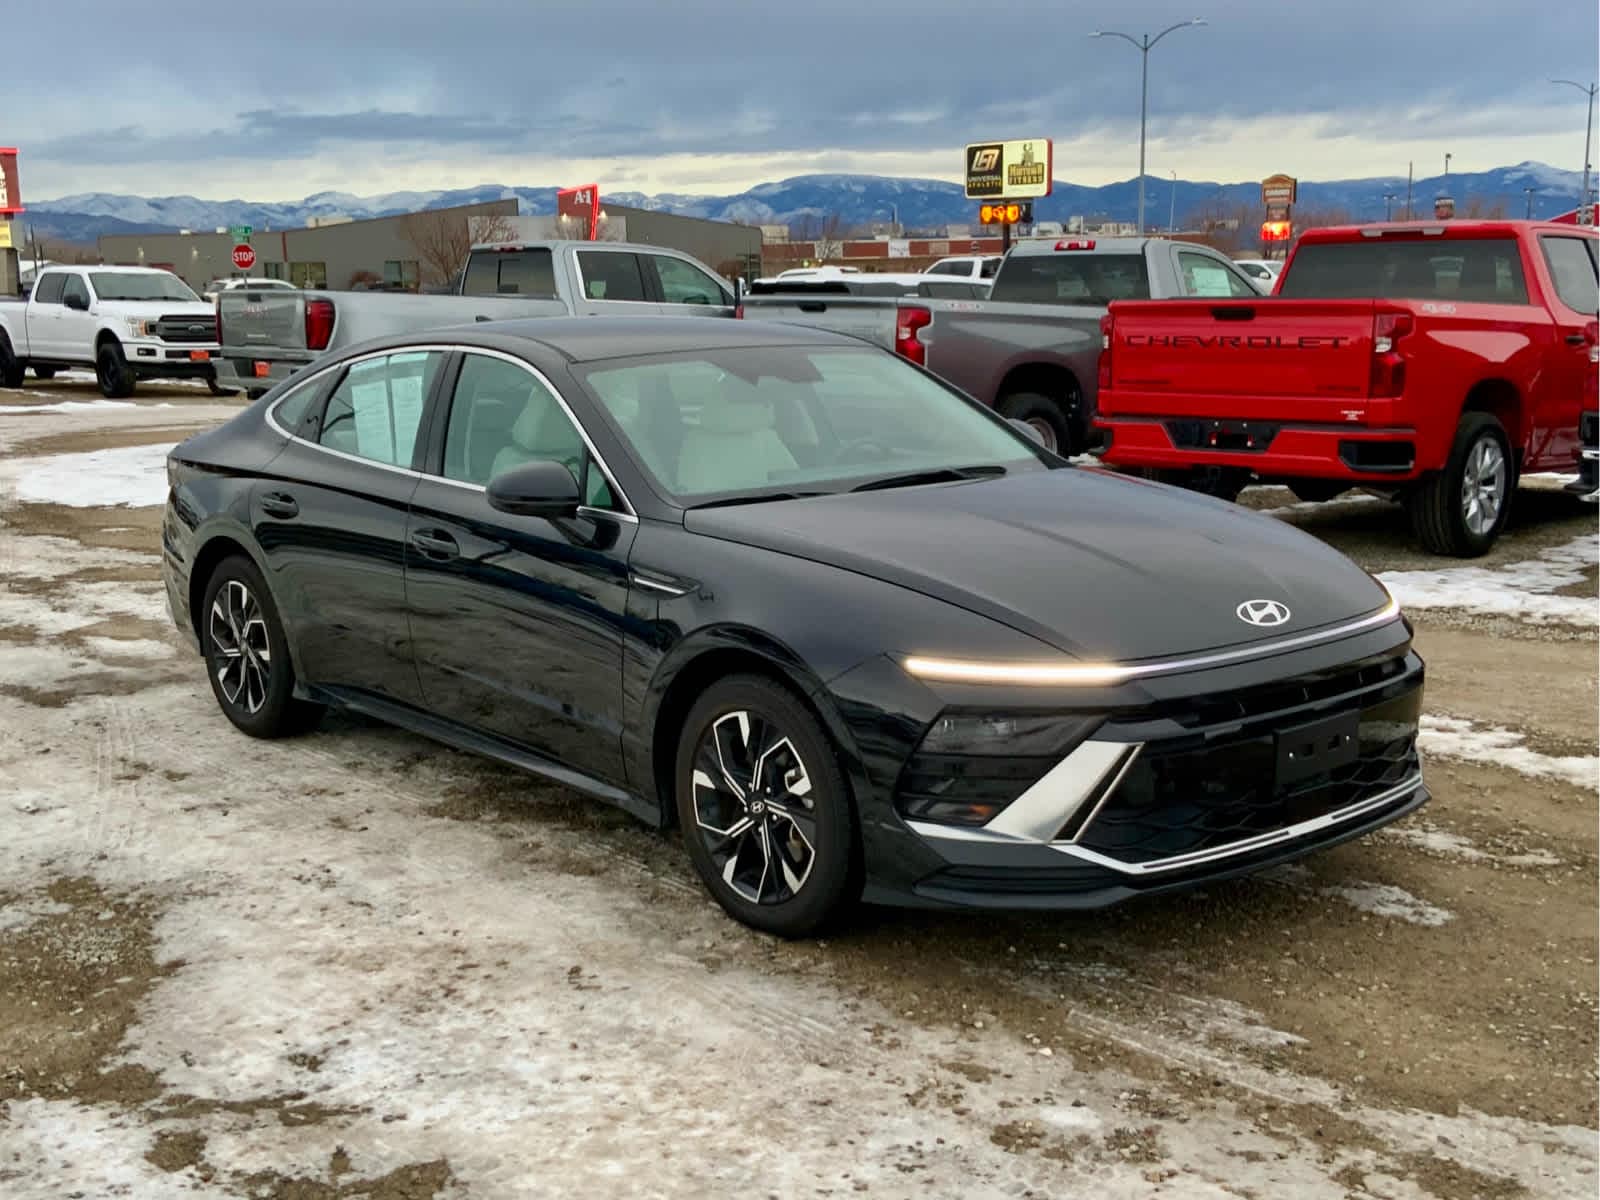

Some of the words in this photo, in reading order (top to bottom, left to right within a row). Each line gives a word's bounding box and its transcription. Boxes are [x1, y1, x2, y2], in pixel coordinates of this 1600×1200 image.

[1009, 176, 1043, 185] FITNESS
[233, 251, 254, 262] STOP
[1126, 335, 1349, 350] CHEVROLET
